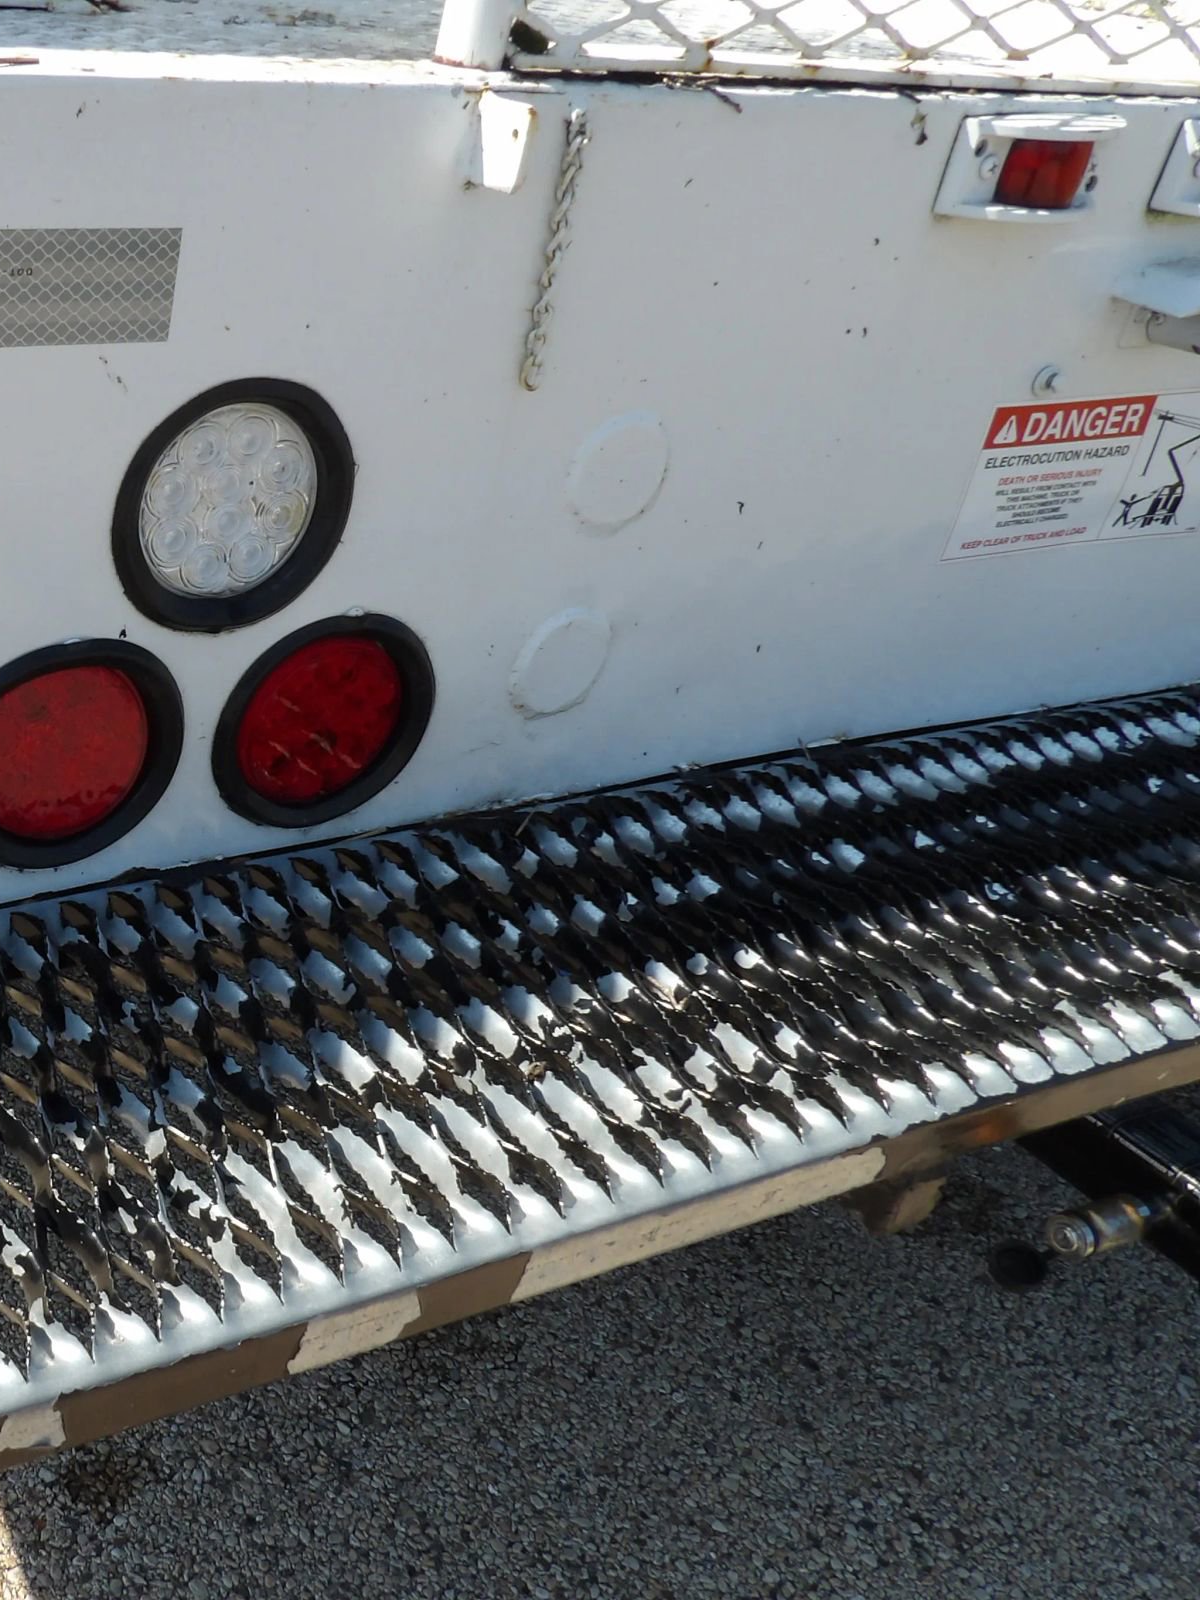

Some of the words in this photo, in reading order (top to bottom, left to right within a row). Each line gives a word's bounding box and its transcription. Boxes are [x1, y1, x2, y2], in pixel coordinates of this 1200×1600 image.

[1021, 403, 1146, 442] DANGER
[984, 449, 1081, 469] ELECTROCUTION
[1083, 445, 1130, 459] HAZARD
[997, 476, 1026, 486] DEATH
[1027, 474, 1040, 483] OR
[1040, 471, 1074, 481] SERIOUS
[1075, 468, 1103, 477] INJURY
[960, 540, 983, 550] KEEP
[982, 537, 1010, 547] CLEAR
[1010, 535, 1023, 544] OF
[1023, 531, 1048, 542] TRUCK
[1048, 529, 1065, 538] AND
[1065, 527, 1087, 537] LOAD
